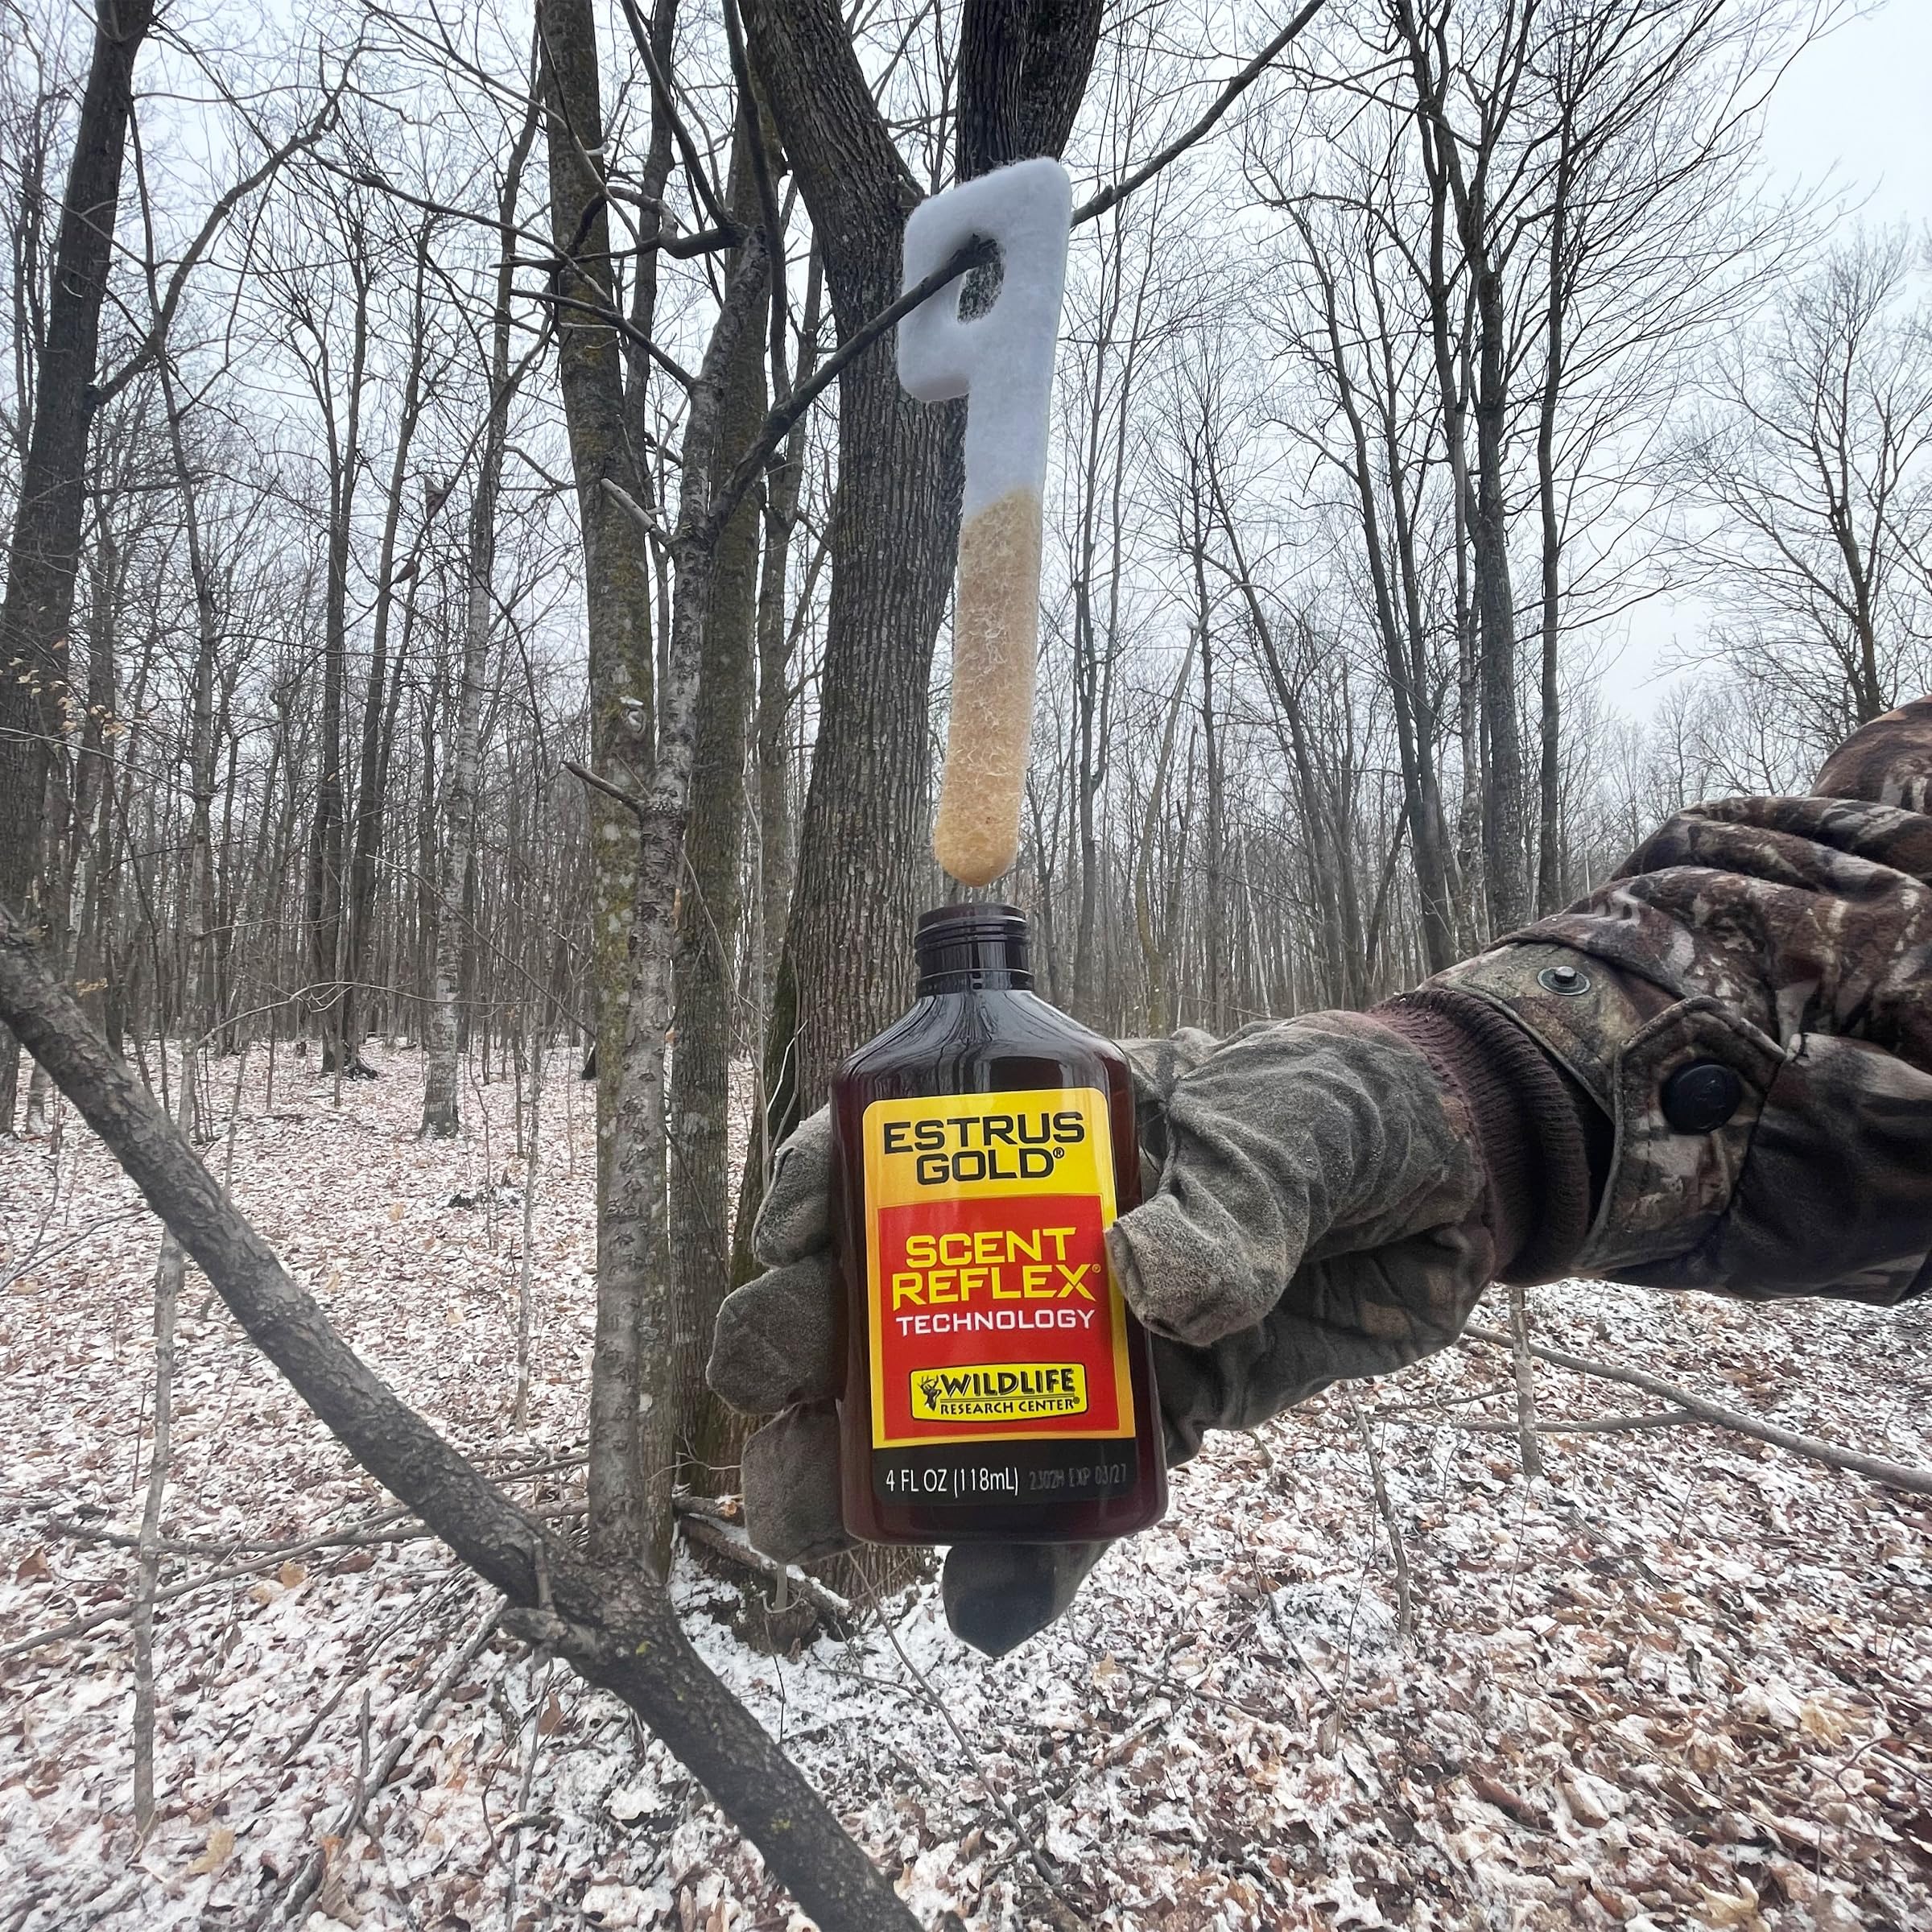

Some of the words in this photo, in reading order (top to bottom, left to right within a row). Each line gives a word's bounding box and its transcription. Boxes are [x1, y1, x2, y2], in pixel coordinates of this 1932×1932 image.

[883, 1111, 1084, 1154] ESTRUS
[905, 1227, 1077, 1268] SCENT
[896, 1309, 1096, 1336] TECHNOLOGY
[939, 1368, 1075, 1397] WILDLIFE
[940, 1402, 1013, 1415] RESEARCH
[886, 1468, 895, 1492] 4
[901, 1469, 919, 1492] FL
[923, 1468, 947, 1492] OZ
[954, 1467, 1018, 1498] (118mL)
[1068, 1467, 1091, 1488] EXP
[1095, 1463, 1126, 1485] 03/27
